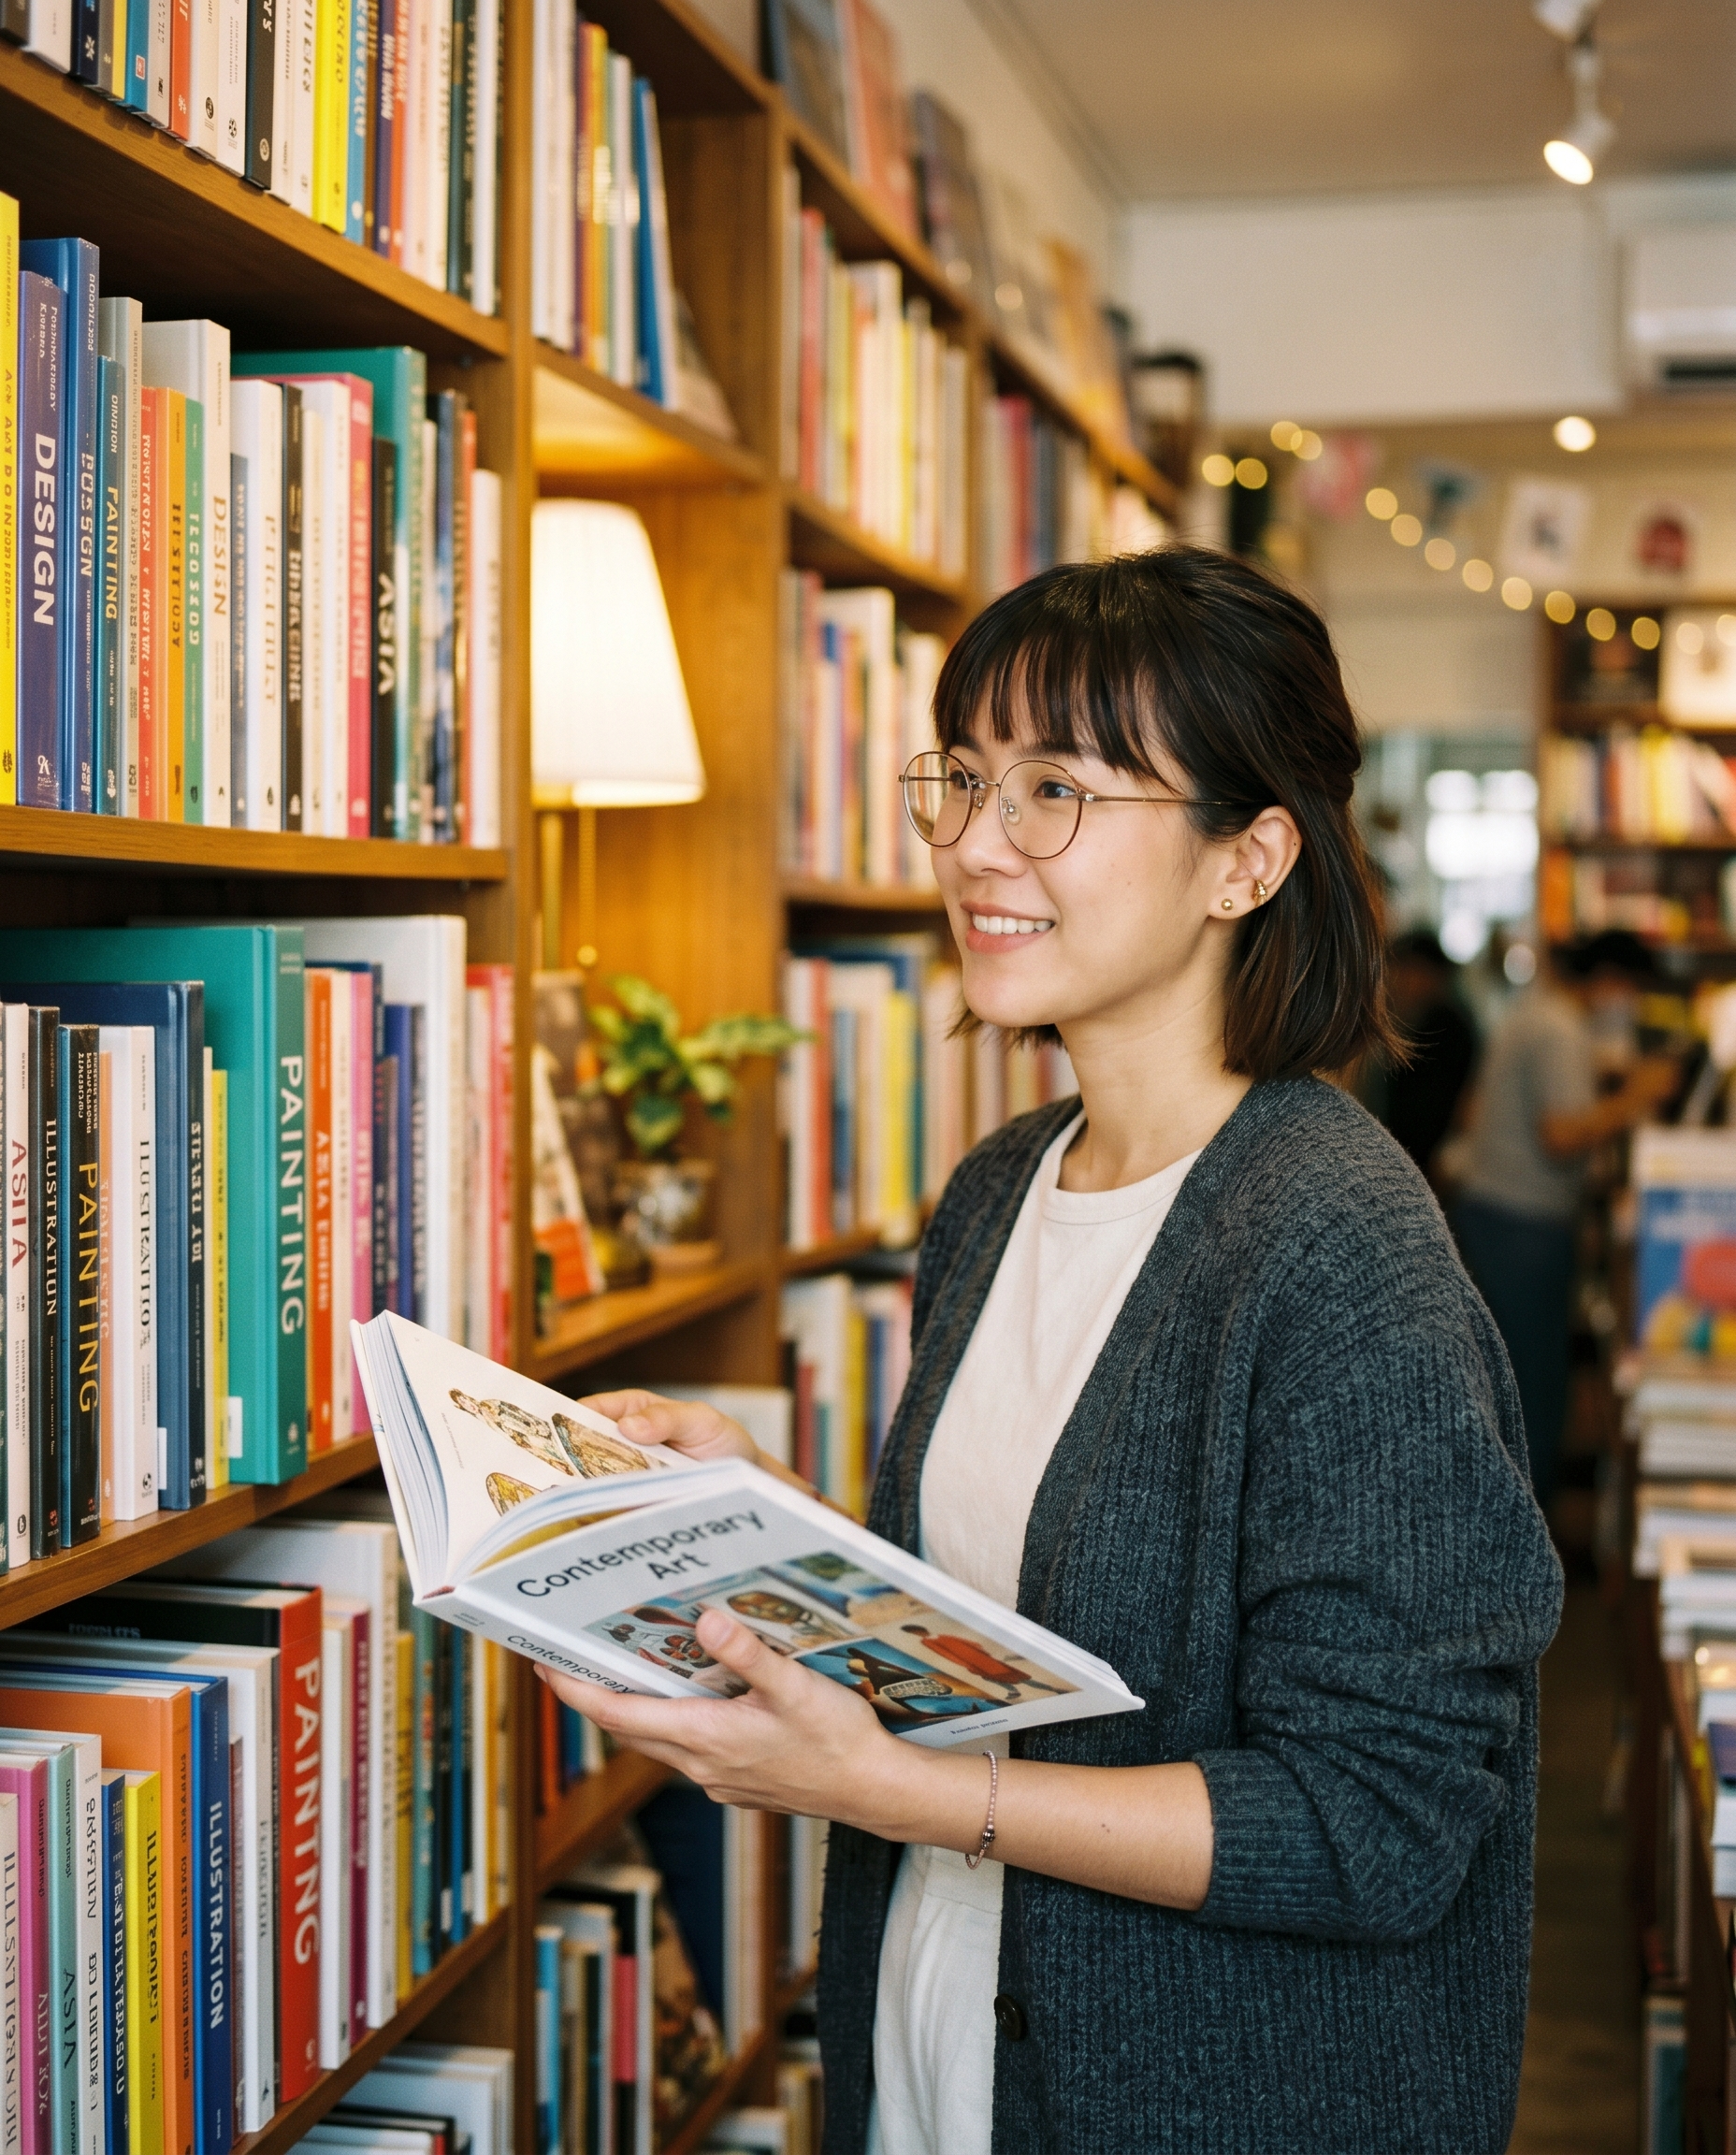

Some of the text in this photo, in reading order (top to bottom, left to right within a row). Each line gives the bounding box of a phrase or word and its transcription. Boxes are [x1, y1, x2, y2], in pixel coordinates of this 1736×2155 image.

[34, 432, 56, 626] DESIGN
[106, 486, 119, 619] PAINTING
[378, 572, 396, 695] ASIA
[281, 1055, 304, 1335] PAINTING
[79, 1163, 99, 1413] PAINTING
[516, 1510, 764, 1598] Contemporary
[647, 1553, 711, 1580] Art
[507, 1634, 636, 1693] Contemporary
[210, 1801, 224, 2030] ILLUSTRATION
[64, 1968, 77, 2069] ASIA
